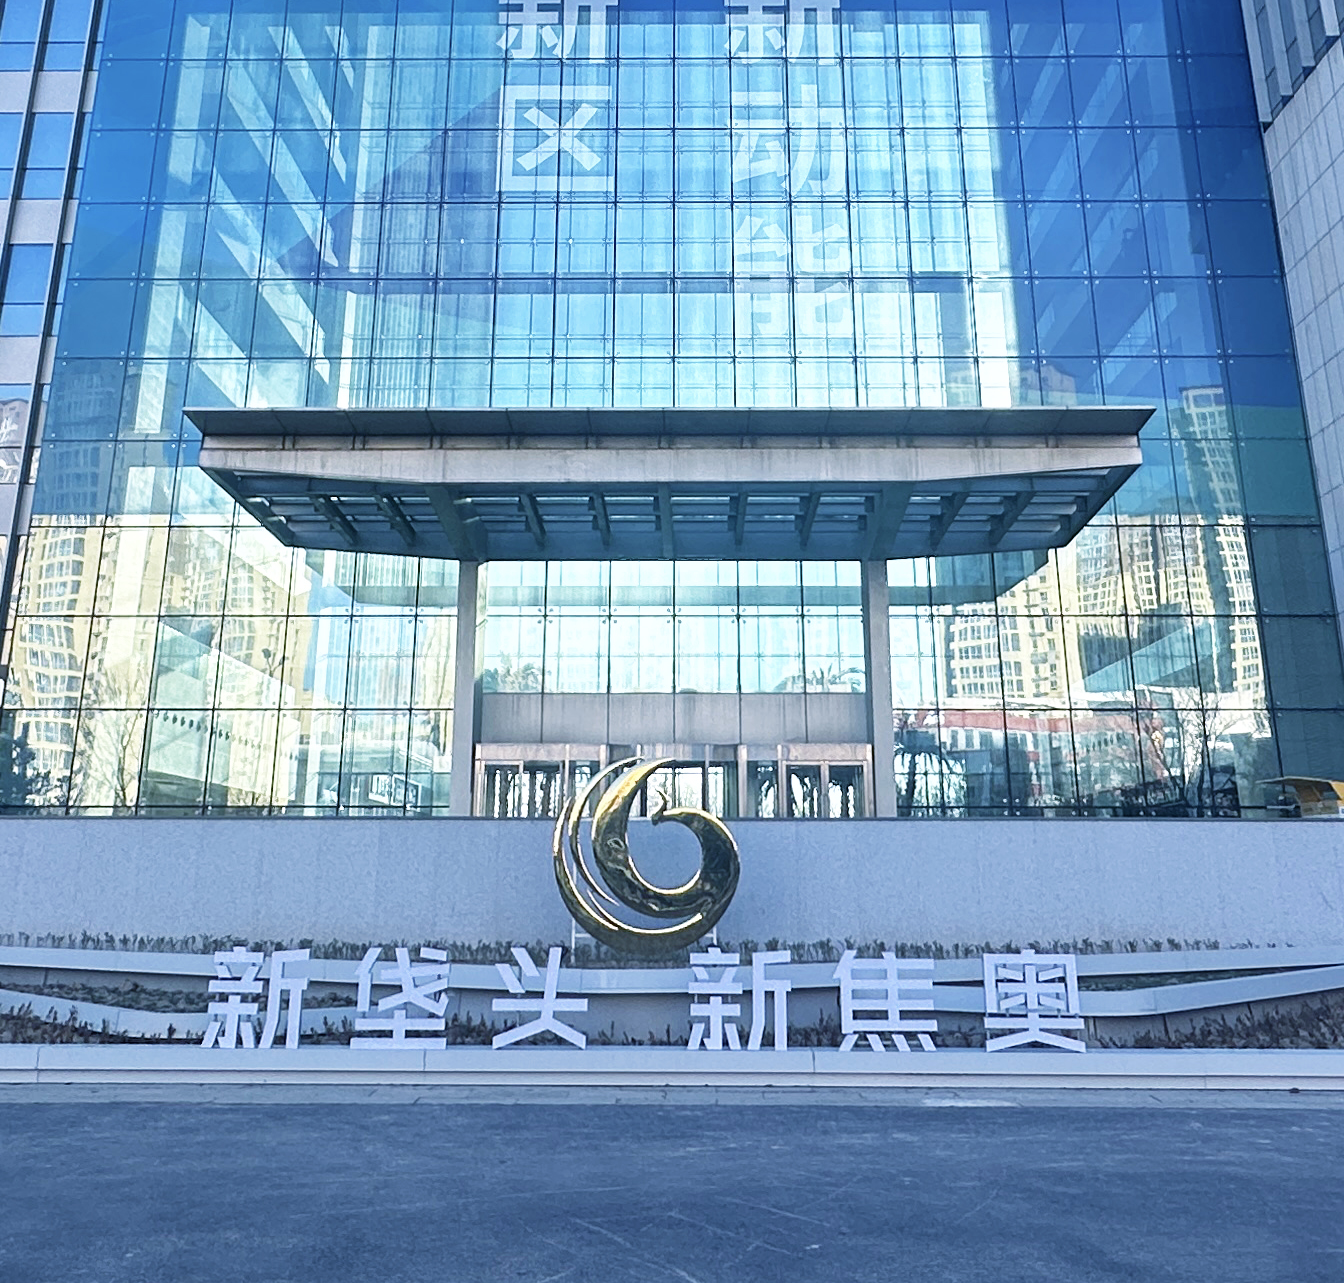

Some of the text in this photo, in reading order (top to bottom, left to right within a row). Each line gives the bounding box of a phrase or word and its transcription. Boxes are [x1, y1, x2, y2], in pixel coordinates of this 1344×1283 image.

[200, 945, 1087, 1054] 新垡头 新焦奥
